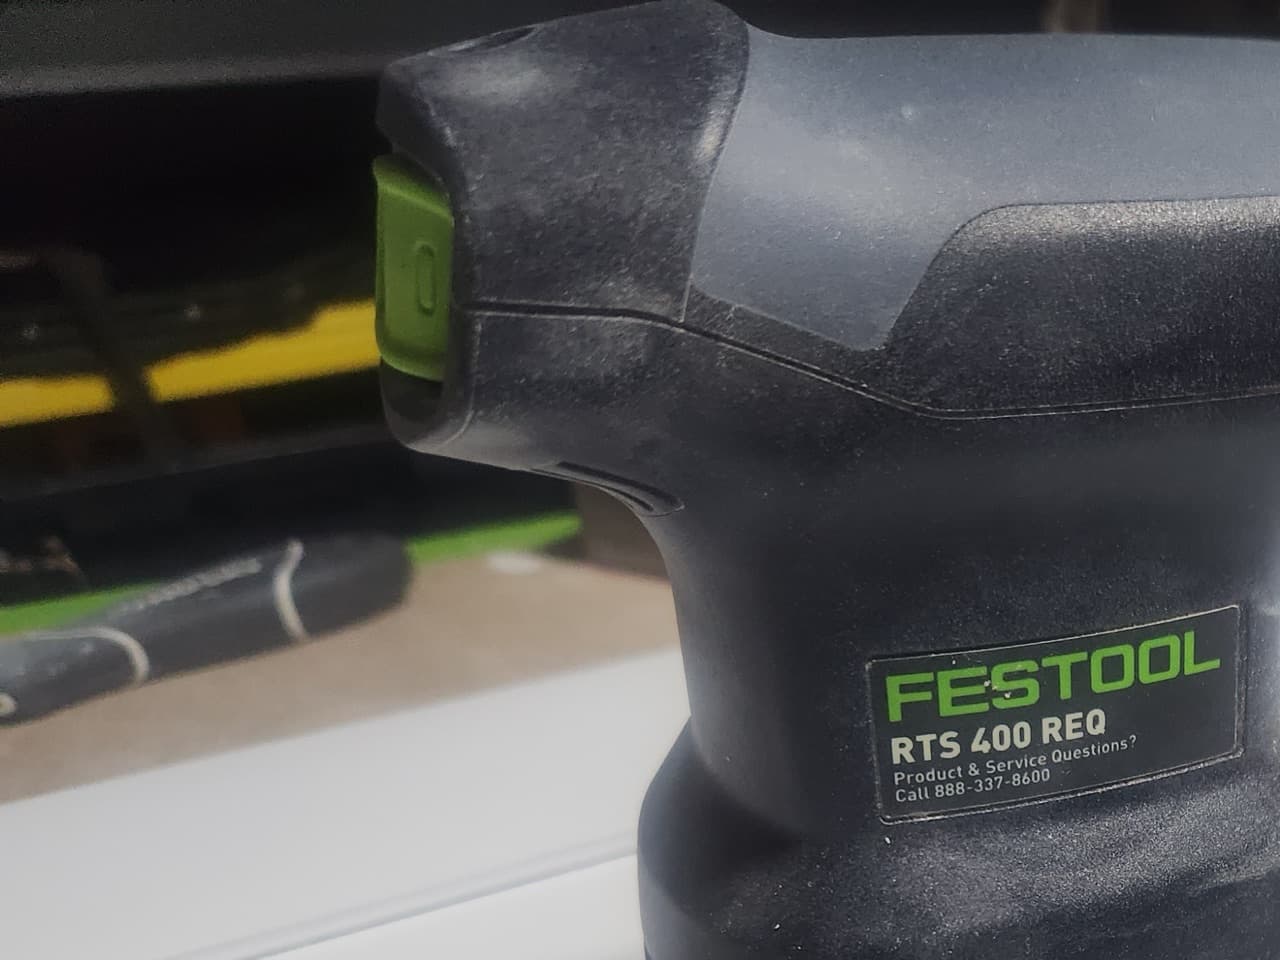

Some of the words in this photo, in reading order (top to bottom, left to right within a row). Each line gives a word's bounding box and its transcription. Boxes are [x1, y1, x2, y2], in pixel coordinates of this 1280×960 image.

[885, 630, 1221, 723] FESTOOL
[890, 730, 961, 765] RTS
[970, 721, 1032, 754] 400
[1041, 708, 1106, 745] REQ
[893, 765, 963, 786] Product
[967, 762, 980, 777] &
[985, 754, 1047, 775] Service
[1051, 734, 1137, 763] Questions?
[895, 786, 930, 803] Call
[934, 768, 1051, 798] 888-337-8600
